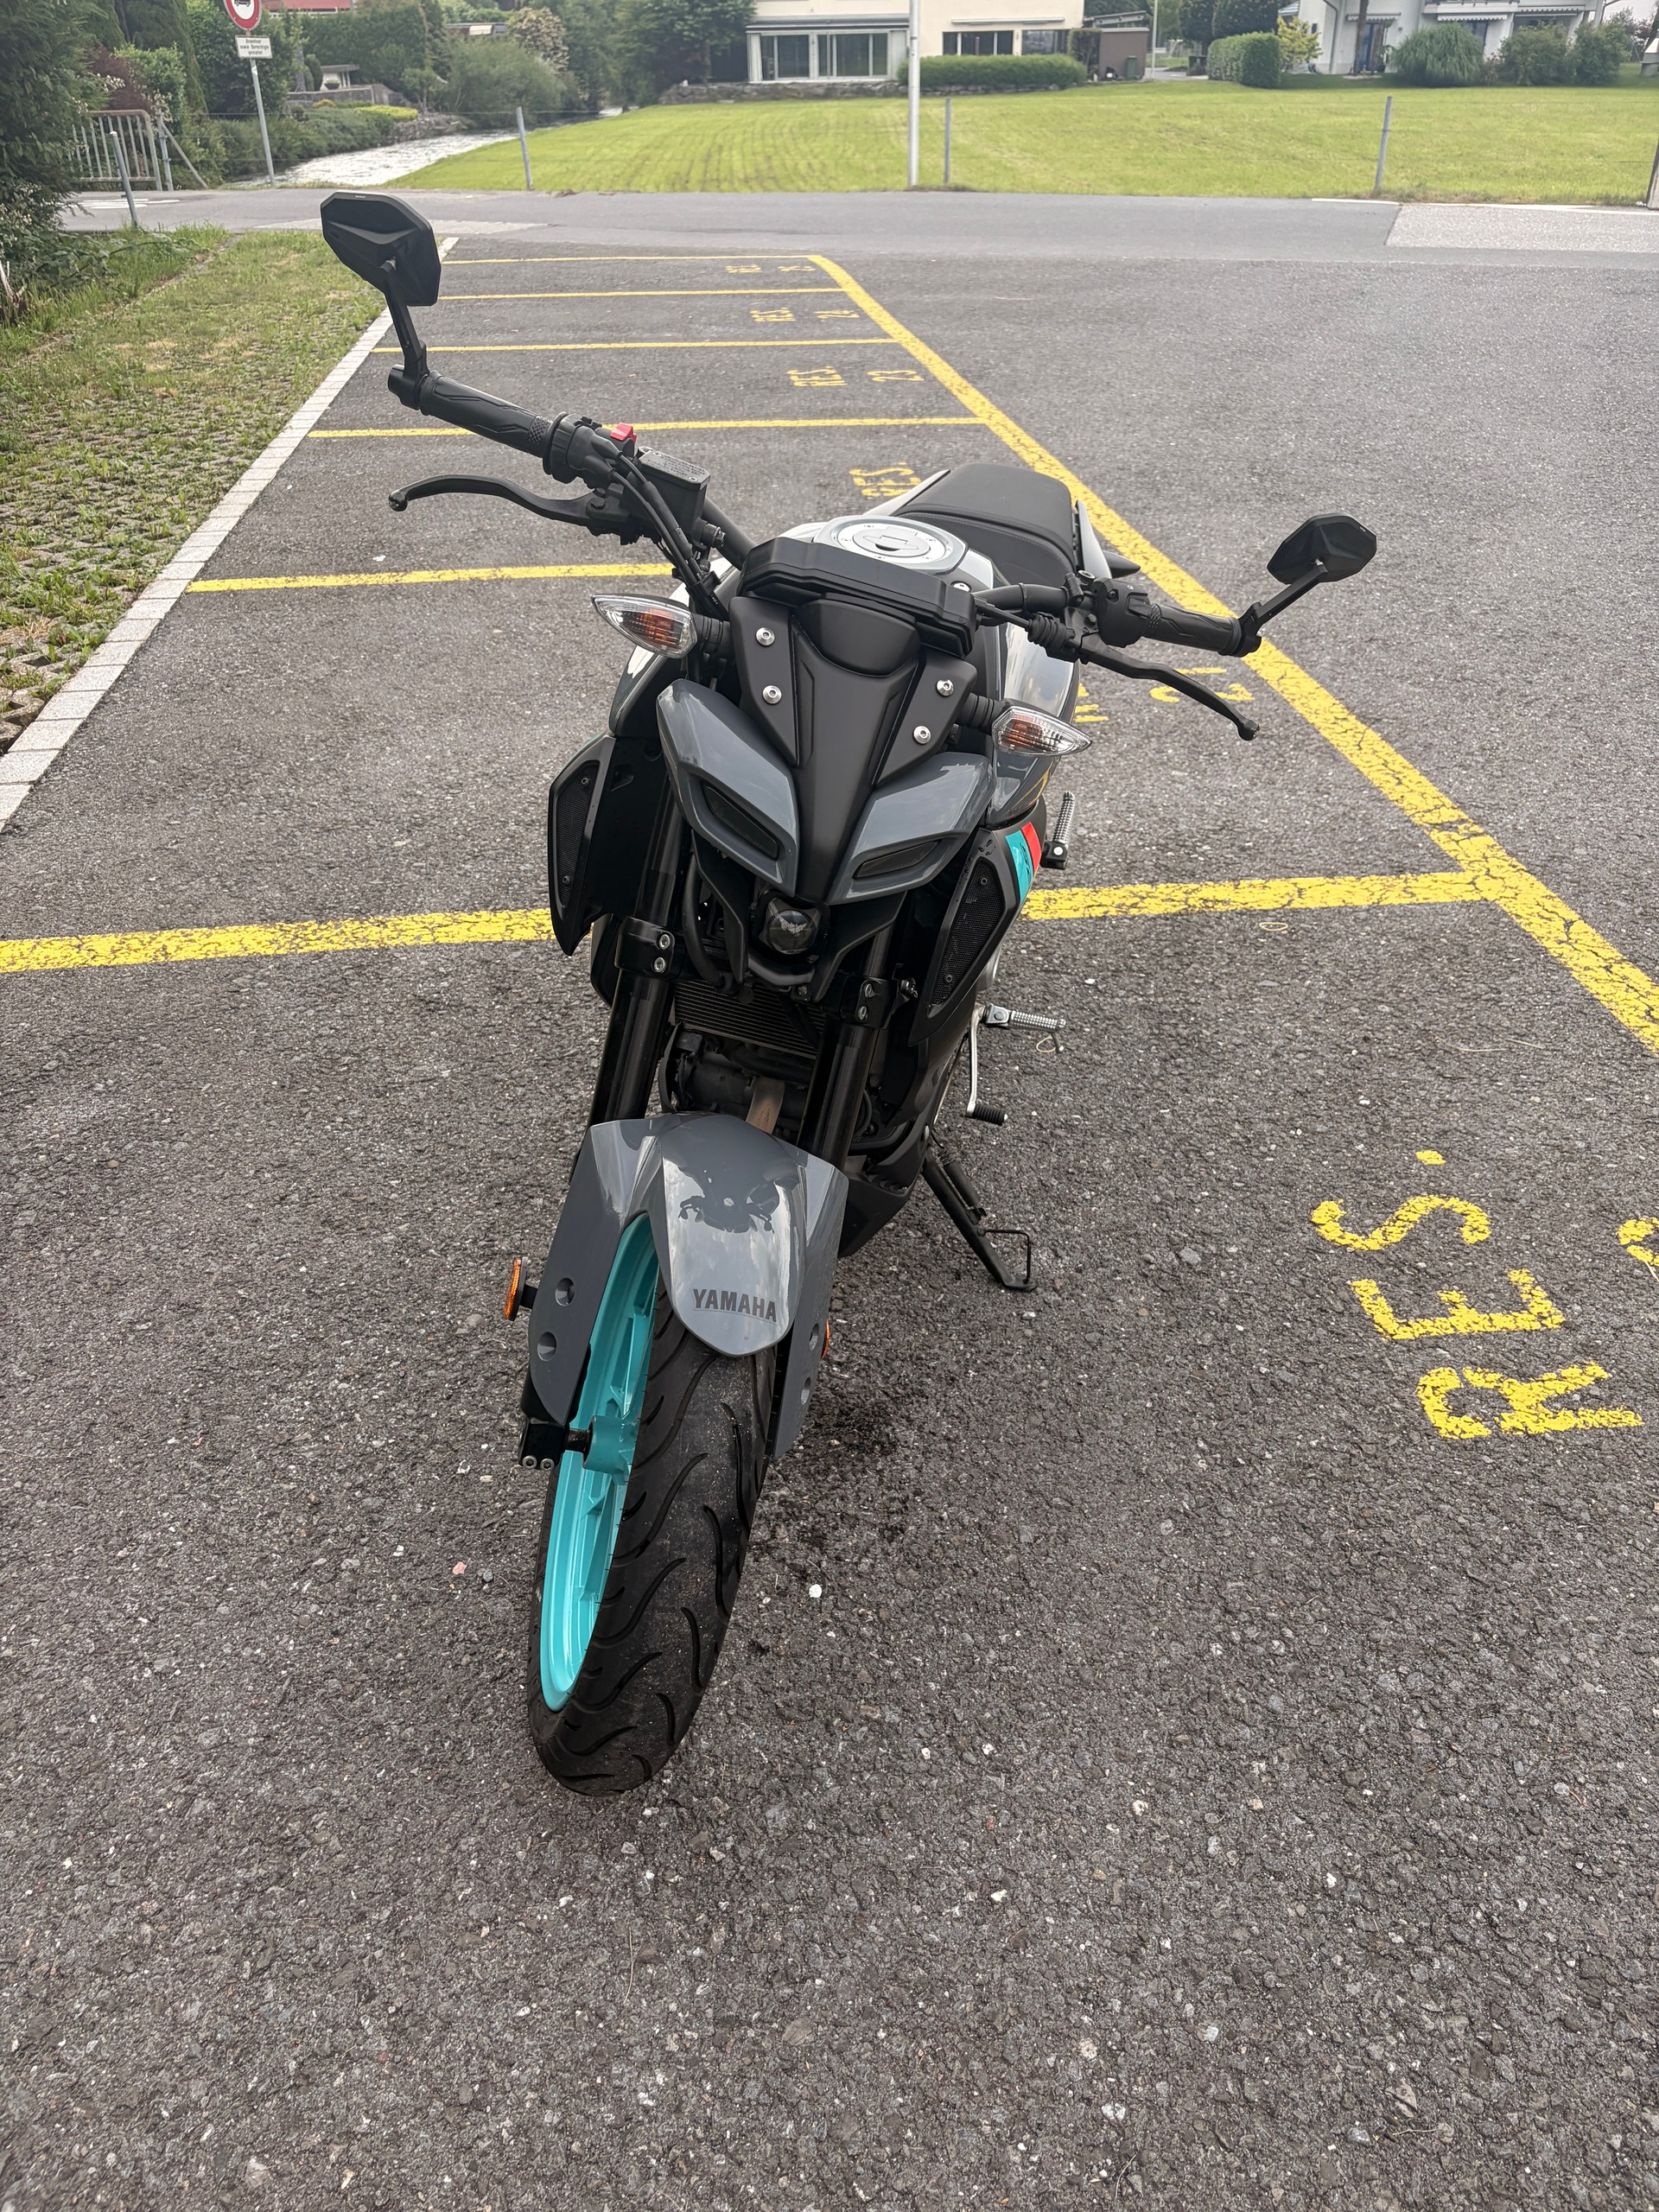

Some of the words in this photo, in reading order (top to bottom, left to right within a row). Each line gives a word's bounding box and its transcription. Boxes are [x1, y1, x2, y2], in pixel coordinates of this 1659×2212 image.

[787, 365, 848, 386] RES.
[867, 370, 925, 382] 23
[849, 461, 921, 497] RES.
[693, 1288, 777, 1323] YAMAHA
[1310, 1150, 1644, 1440] RES.
